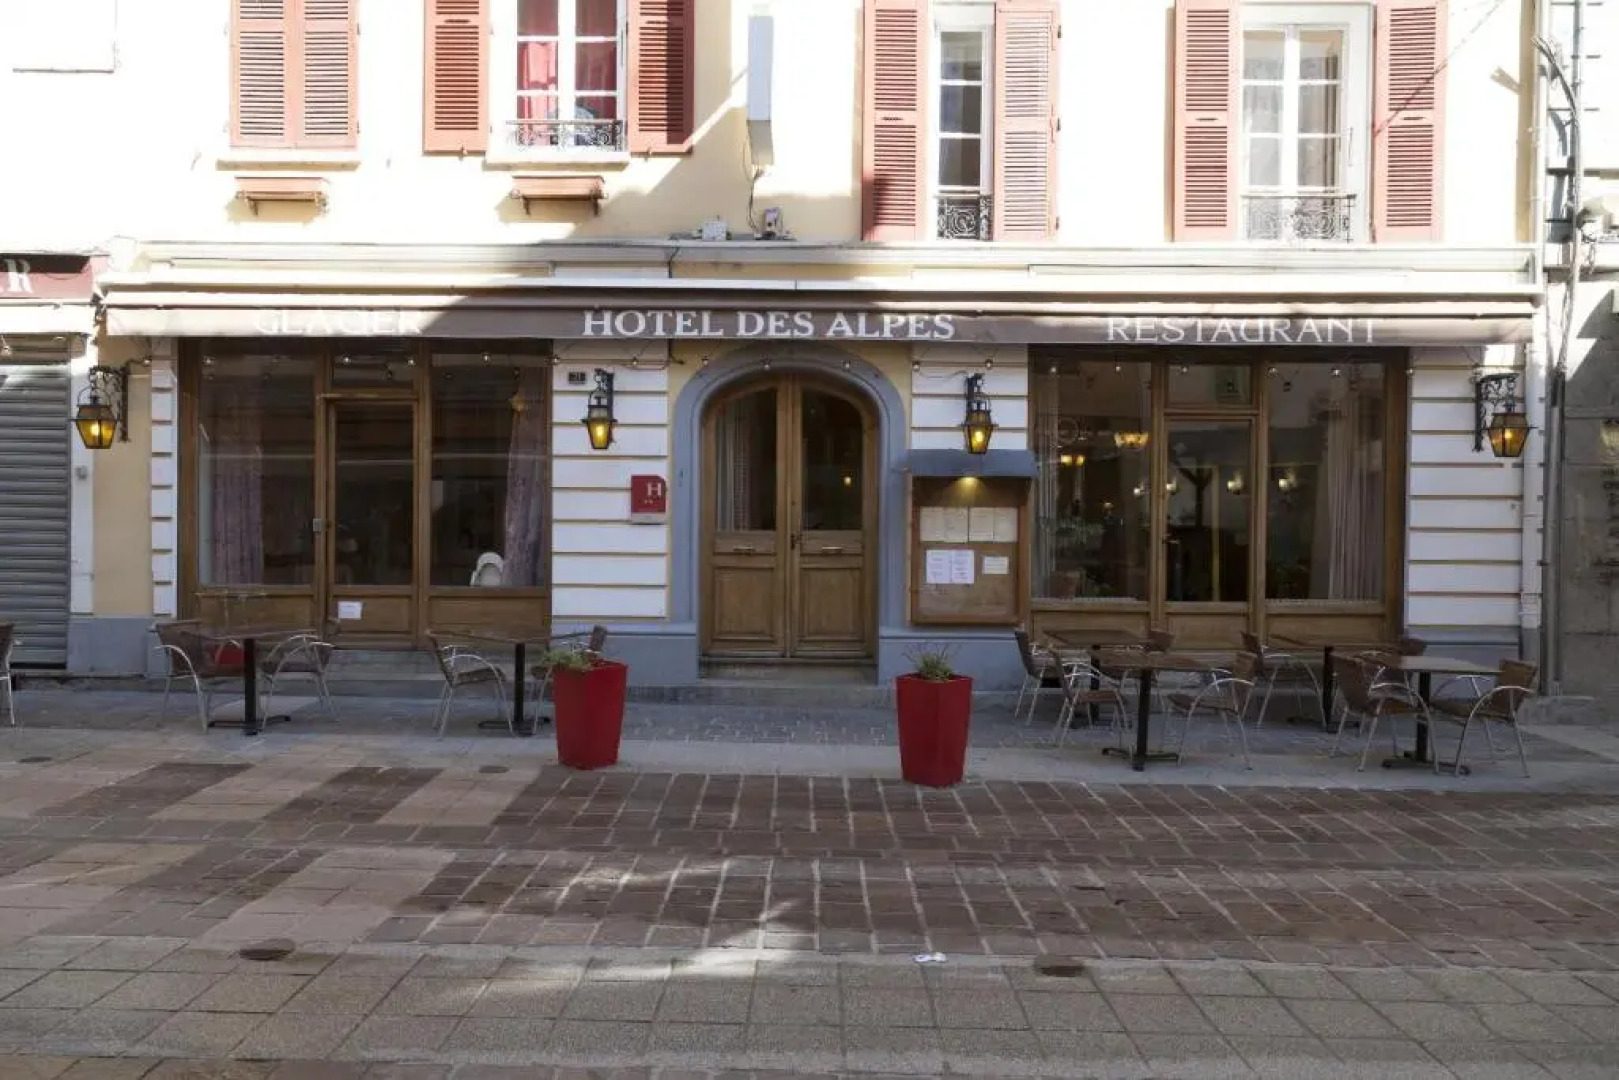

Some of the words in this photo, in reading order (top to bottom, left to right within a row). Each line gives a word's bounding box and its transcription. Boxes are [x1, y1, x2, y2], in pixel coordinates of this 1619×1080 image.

[0, 258, 34, 293] R
[252, 310, 422, 336] GLACIER
[582, 309, 724, 336] HOTEL
[736, 310, 815, 338] DES
[826, 311, 956, 340] ALPES
[1106, 316, 1375, 343] RESTAURANT
[647, 482, 662, 496] H
